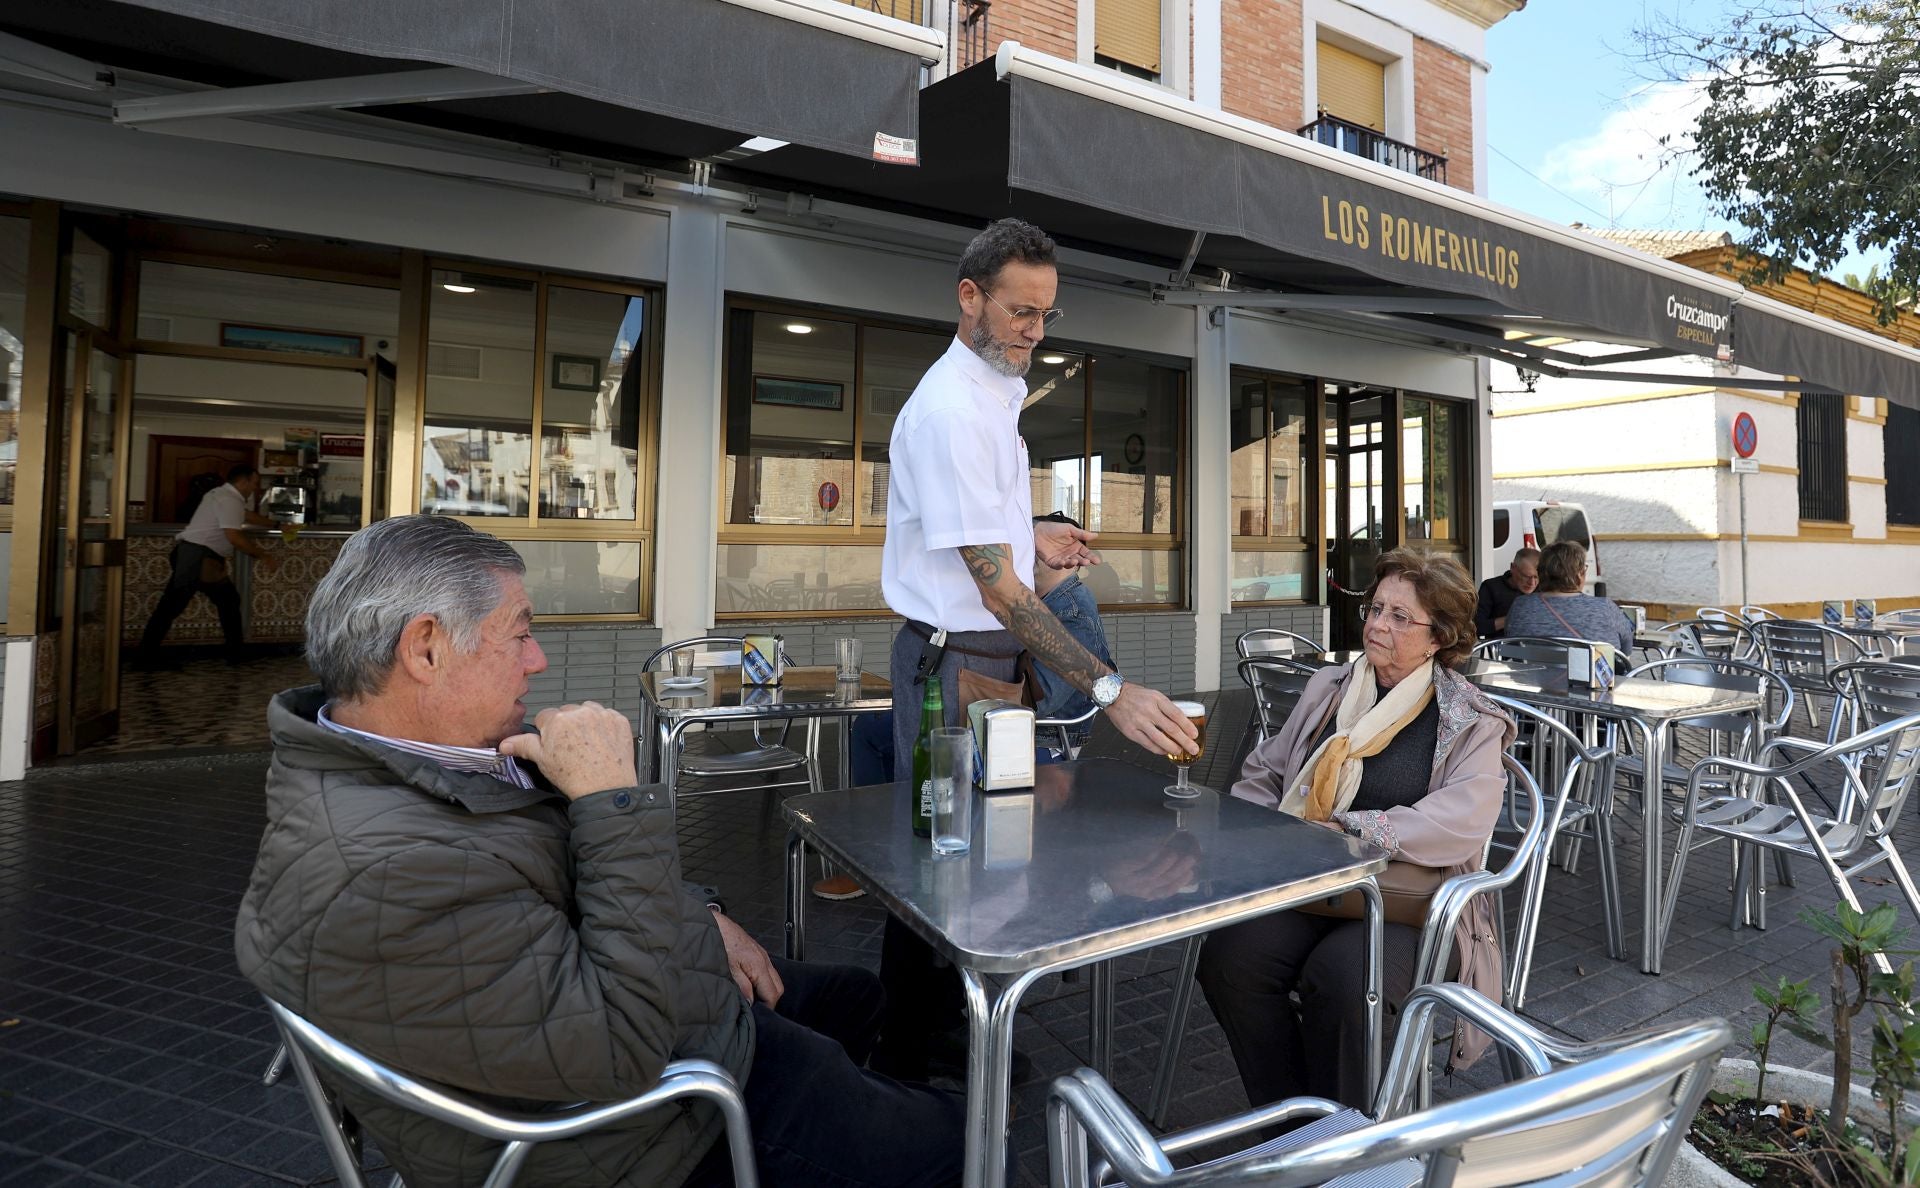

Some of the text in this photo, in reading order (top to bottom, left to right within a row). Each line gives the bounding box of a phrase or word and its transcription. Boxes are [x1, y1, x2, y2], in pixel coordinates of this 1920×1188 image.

[1322, 195, 1520, 290] LOS ROMERILLOS
[1676, 324, 1716, 347] ESPECIAL
